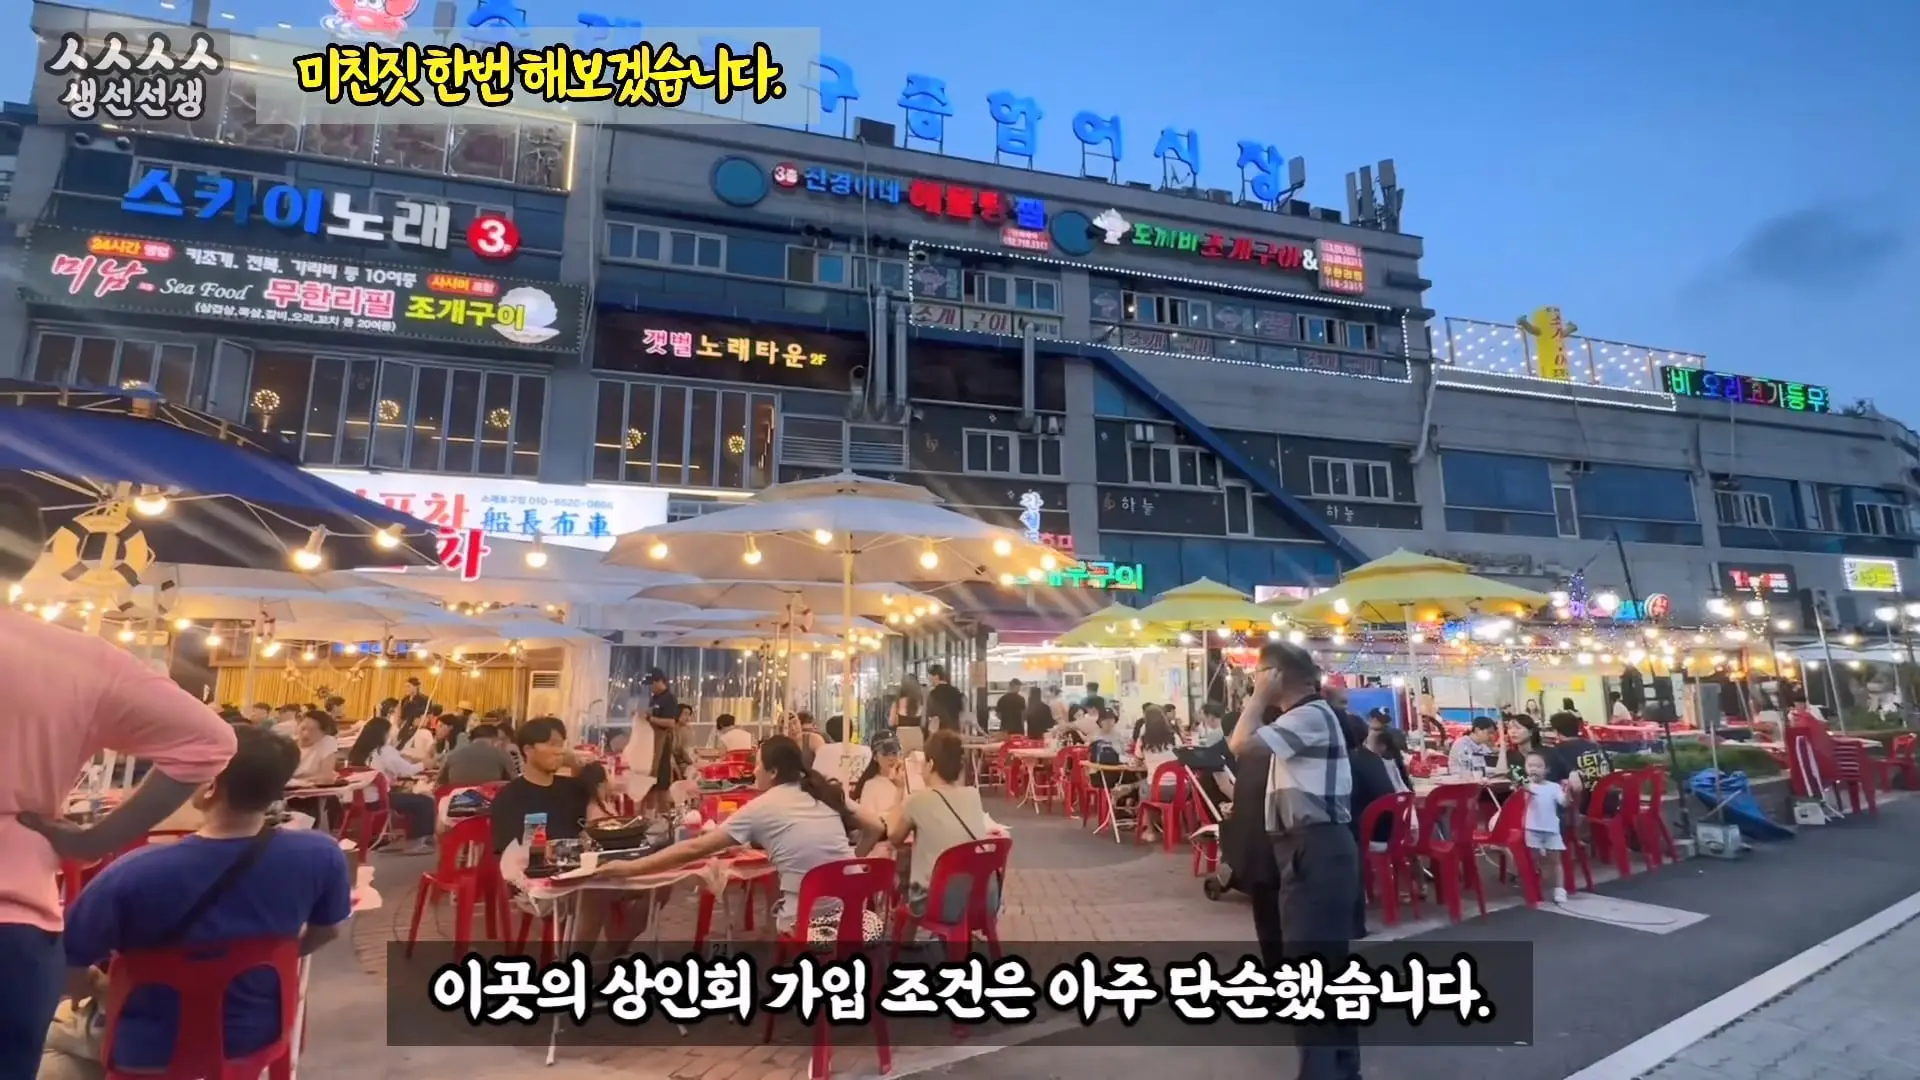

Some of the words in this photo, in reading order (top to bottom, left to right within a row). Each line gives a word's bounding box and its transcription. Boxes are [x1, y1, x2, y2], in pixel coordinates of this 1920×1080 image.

[291, 260, 337, 279] 가리비
[1303, 249, 1318, 270] &
[160, 278, 195, 296] Sea
[200, 281, 253, 300] Food
[263, 278, 395, 319] 무한리필
[405, 295, 526, 331] 조개구이
[643, 329, 692, 358] 갯벌
[696, 334, 808, 368] 노래타운
[1121, 496, 1154, 516] 하늘
[1326, 504, 1355, 523] 하늘
